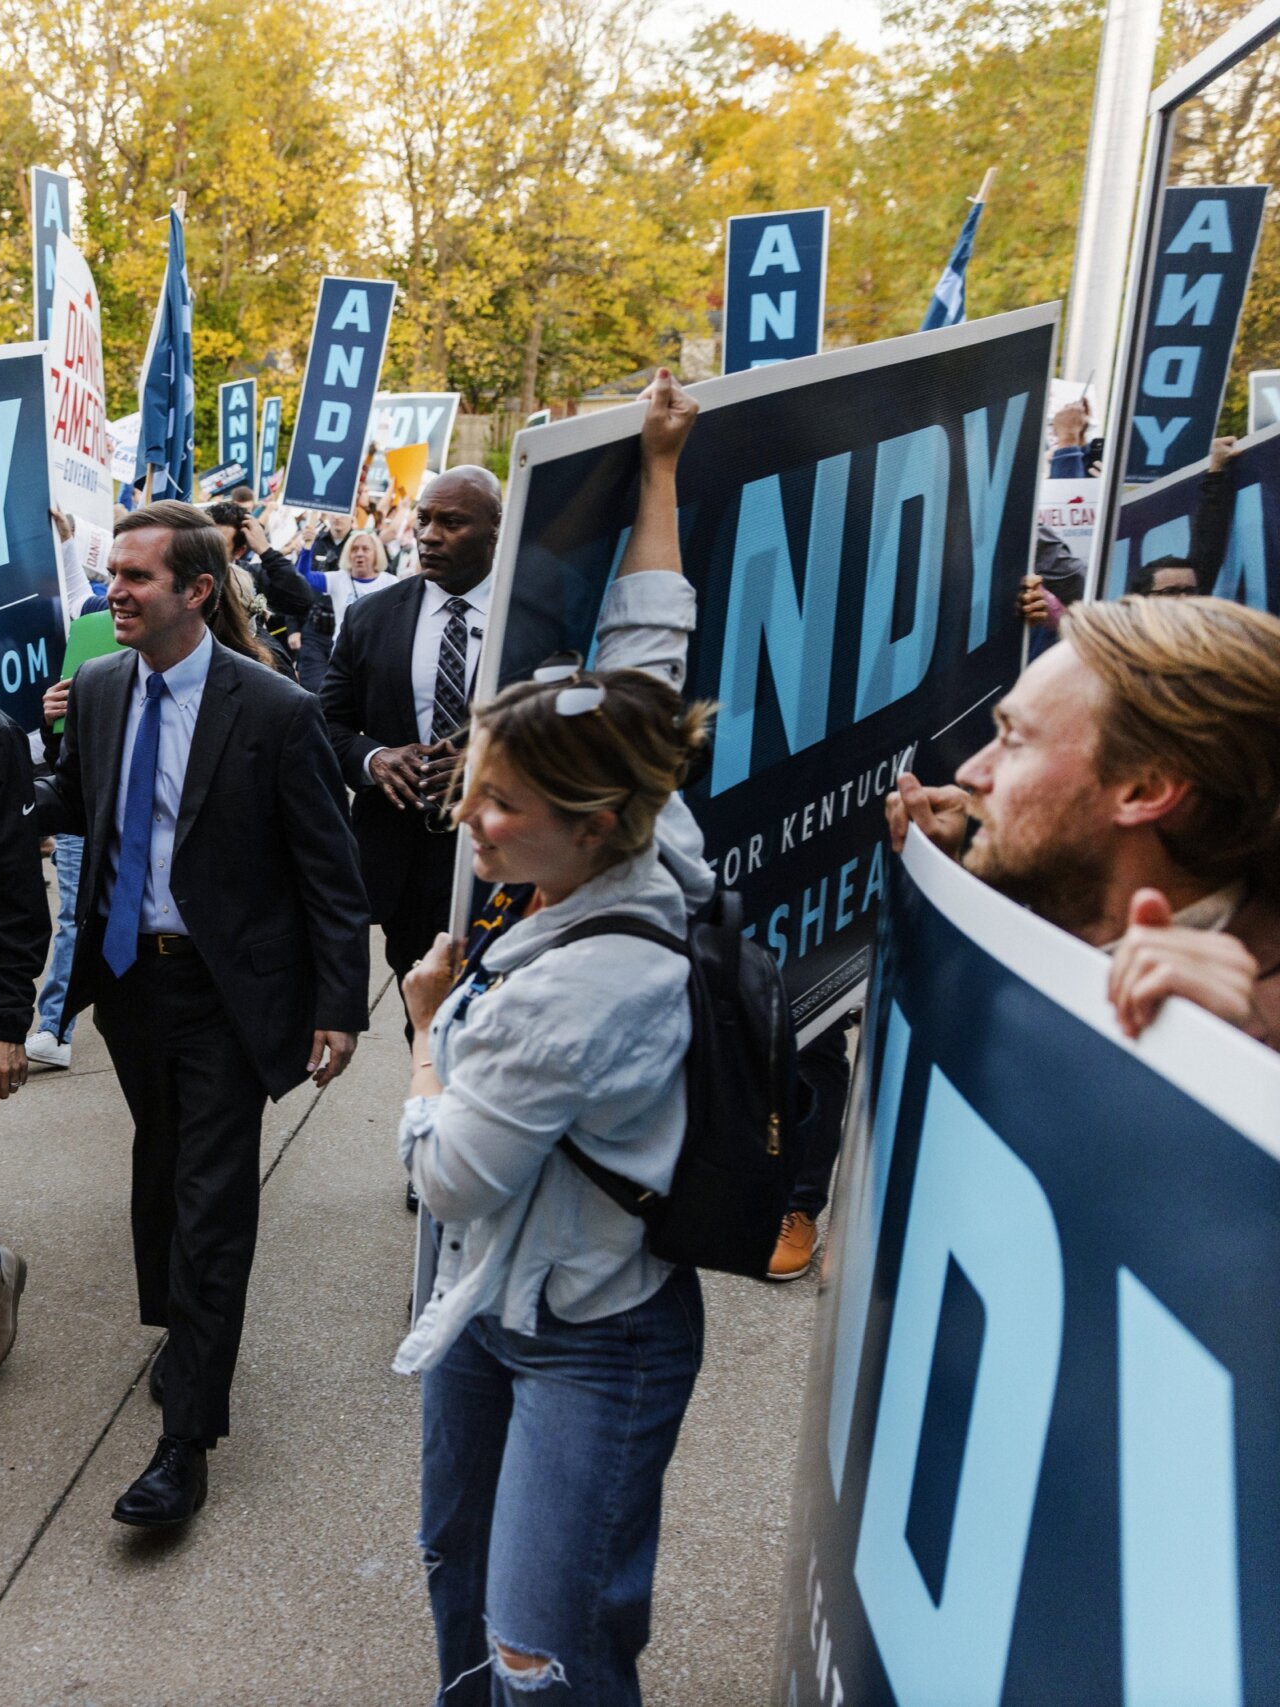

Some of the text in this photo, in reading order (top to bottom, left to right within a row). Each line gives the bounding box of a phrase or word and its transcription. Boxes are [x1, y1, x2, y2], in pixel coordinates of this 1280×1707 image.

[748, 224, 801, 368] AN
[228, 386, 249, 475] AND
[307, 289, 370, 496] ANDY
[584, 391, 1029, 798] NDY
[708, 833, 763, 887] OR
[740, 841, 884, 971] SHEA
